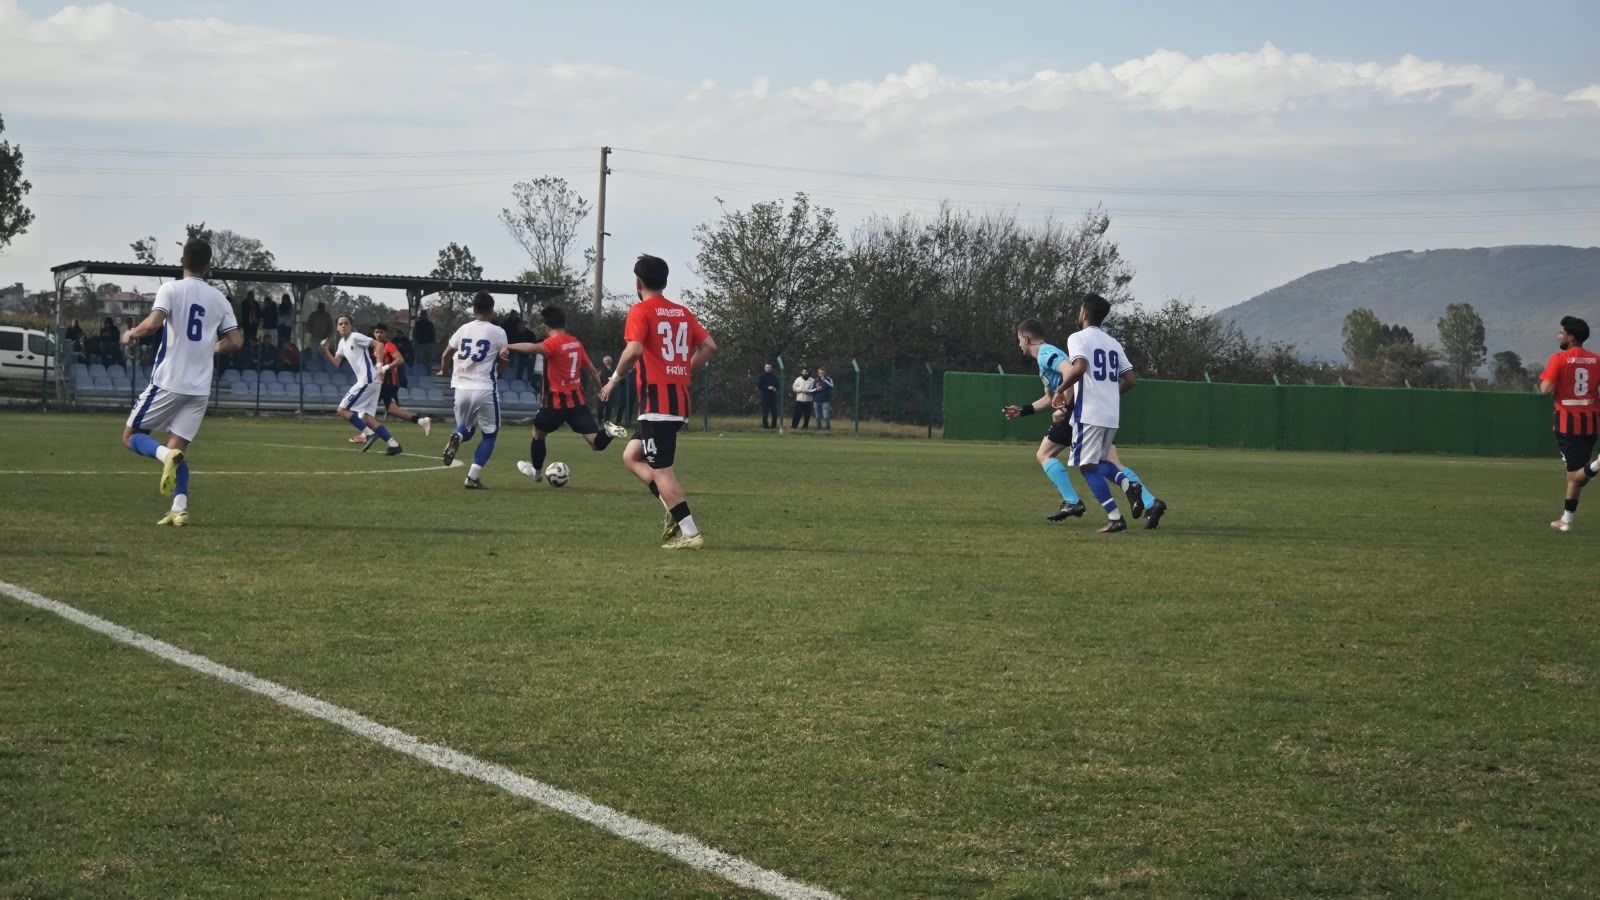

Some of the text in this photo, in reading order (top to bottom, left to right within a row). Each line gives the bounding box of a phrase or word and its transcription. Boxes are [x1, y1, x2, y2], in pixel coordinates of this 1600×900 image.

[187, 304, 205, 341] 6
[458, 339, 490, 362] 53
[657, 321, 688, 361] 34
[568, 351, 578, 378] 7
[1094, 349, 1119, 382] 99
[1574, 367, 1588, 396] 8
